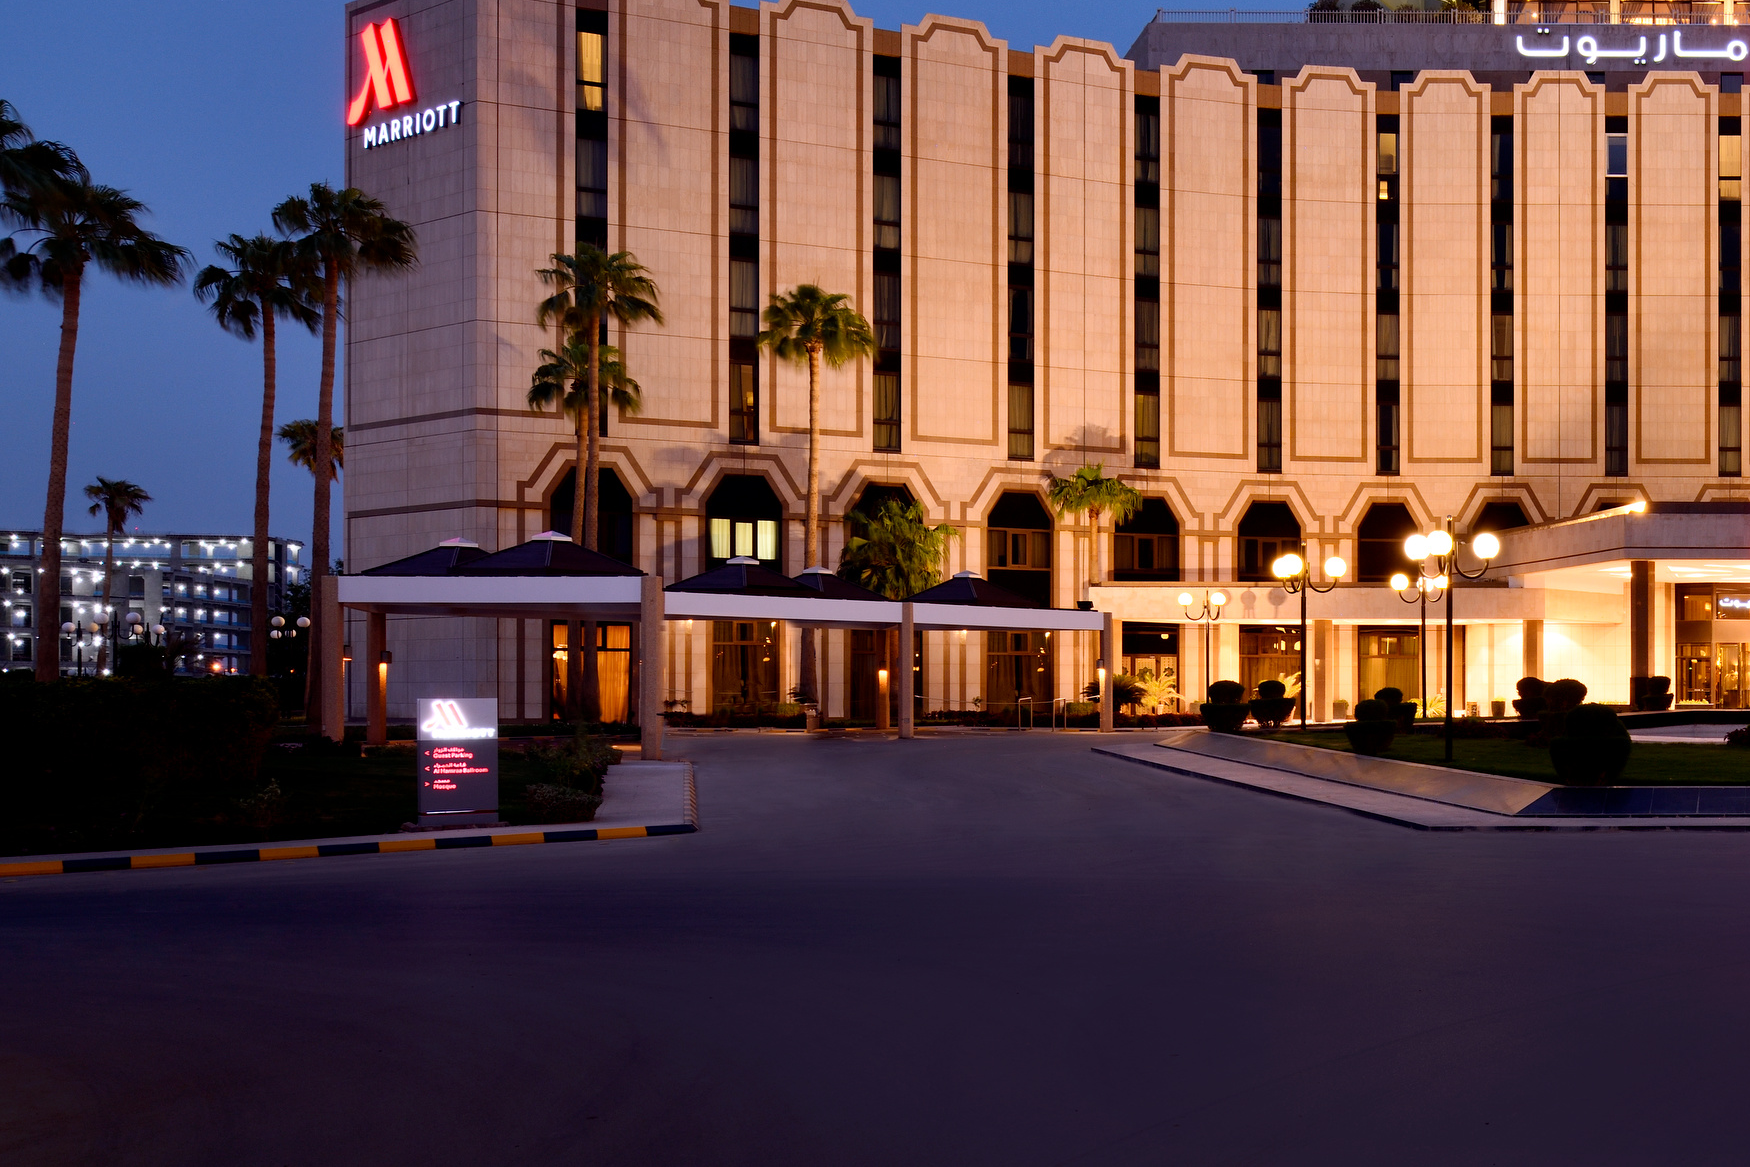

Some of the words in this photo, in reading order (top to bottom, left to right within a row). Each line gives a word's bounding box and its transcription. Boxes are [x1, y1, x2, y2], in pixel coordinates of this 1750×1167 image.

[1516, 27, 1749, 66] ماريوت
[363, 100, 463, 150] MARRIOTT
[451, 752, 474, 760] Parking
[433, 783, 457, 791] Mosque
